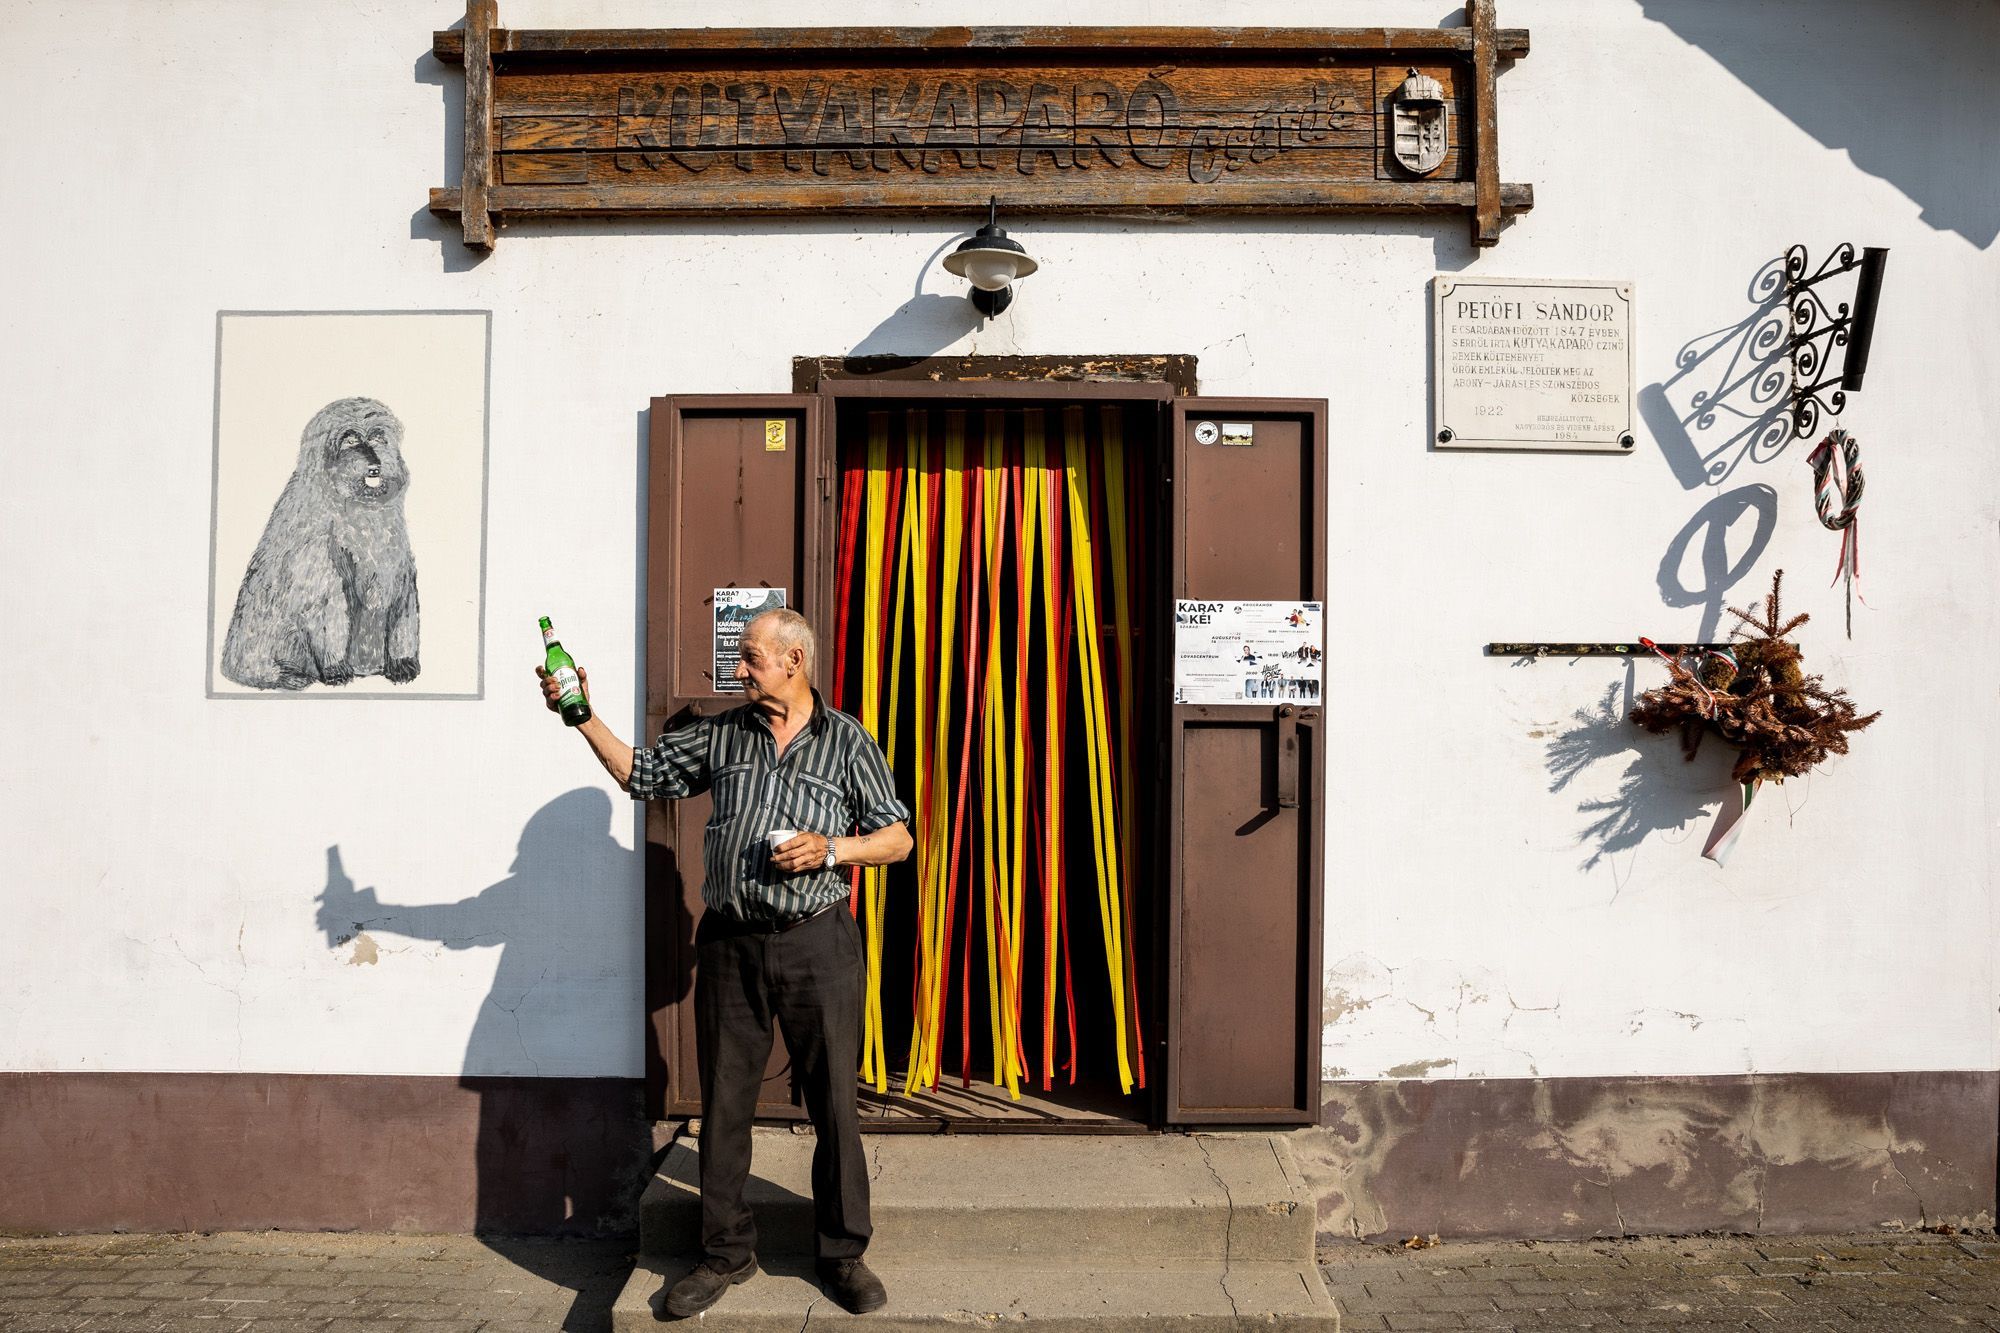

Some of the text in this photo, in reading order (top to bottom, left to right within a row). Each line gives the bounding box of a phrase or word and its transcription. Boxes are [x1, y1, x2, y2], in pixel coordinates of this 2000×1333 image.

[615, 65, 1178, 176] KUTYAKAPARÓ
[1536, 296, 1614, 322] SÁNDOR
[1555, 326, 1585, 337] 1847
[1474, 405, 1504, 416] 1922
[1178, 602, 1224, 613] KARA?
